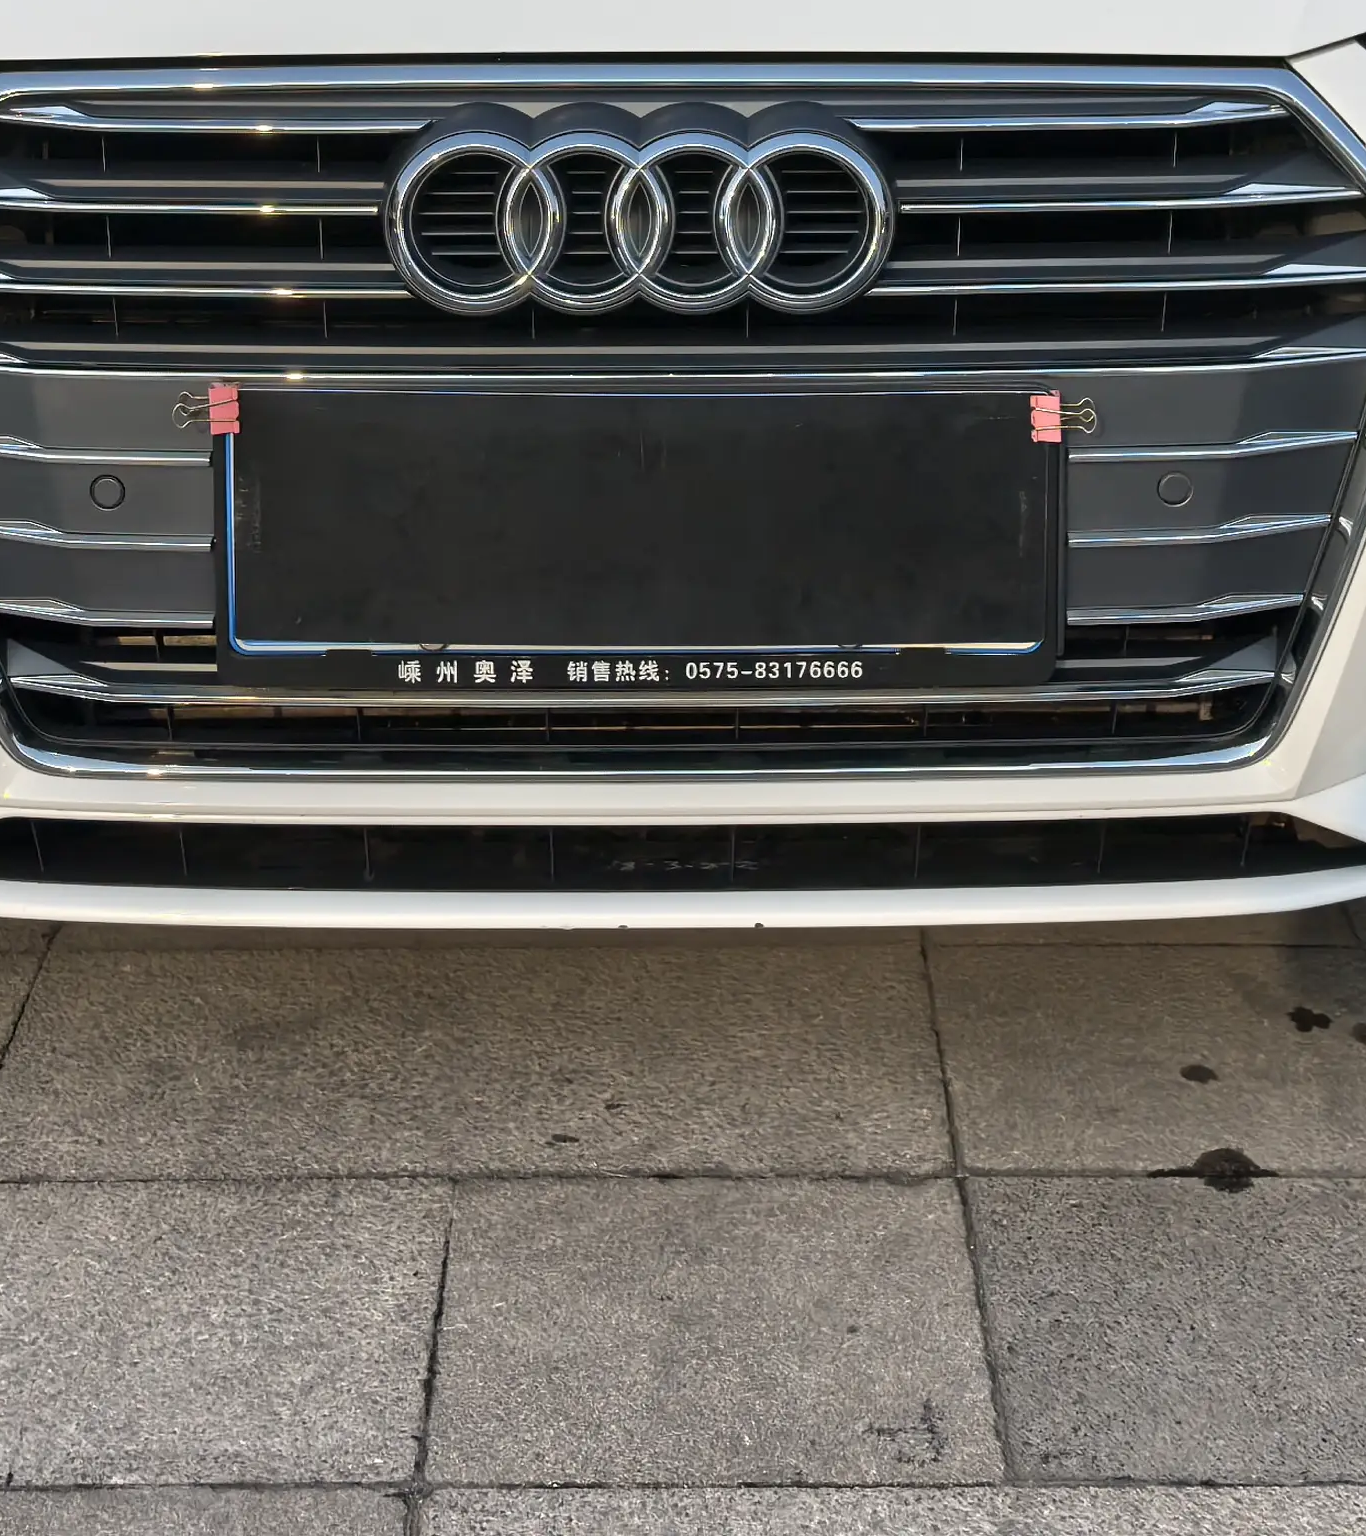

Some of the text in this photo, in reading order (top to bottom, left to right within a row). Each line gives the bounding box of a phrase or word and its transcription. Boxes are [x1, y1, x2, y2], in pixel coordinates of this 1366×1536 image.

[398, 660, 534, 683] 嵊州奥泽
[685, 661, 864, 679] 0575-83176666
